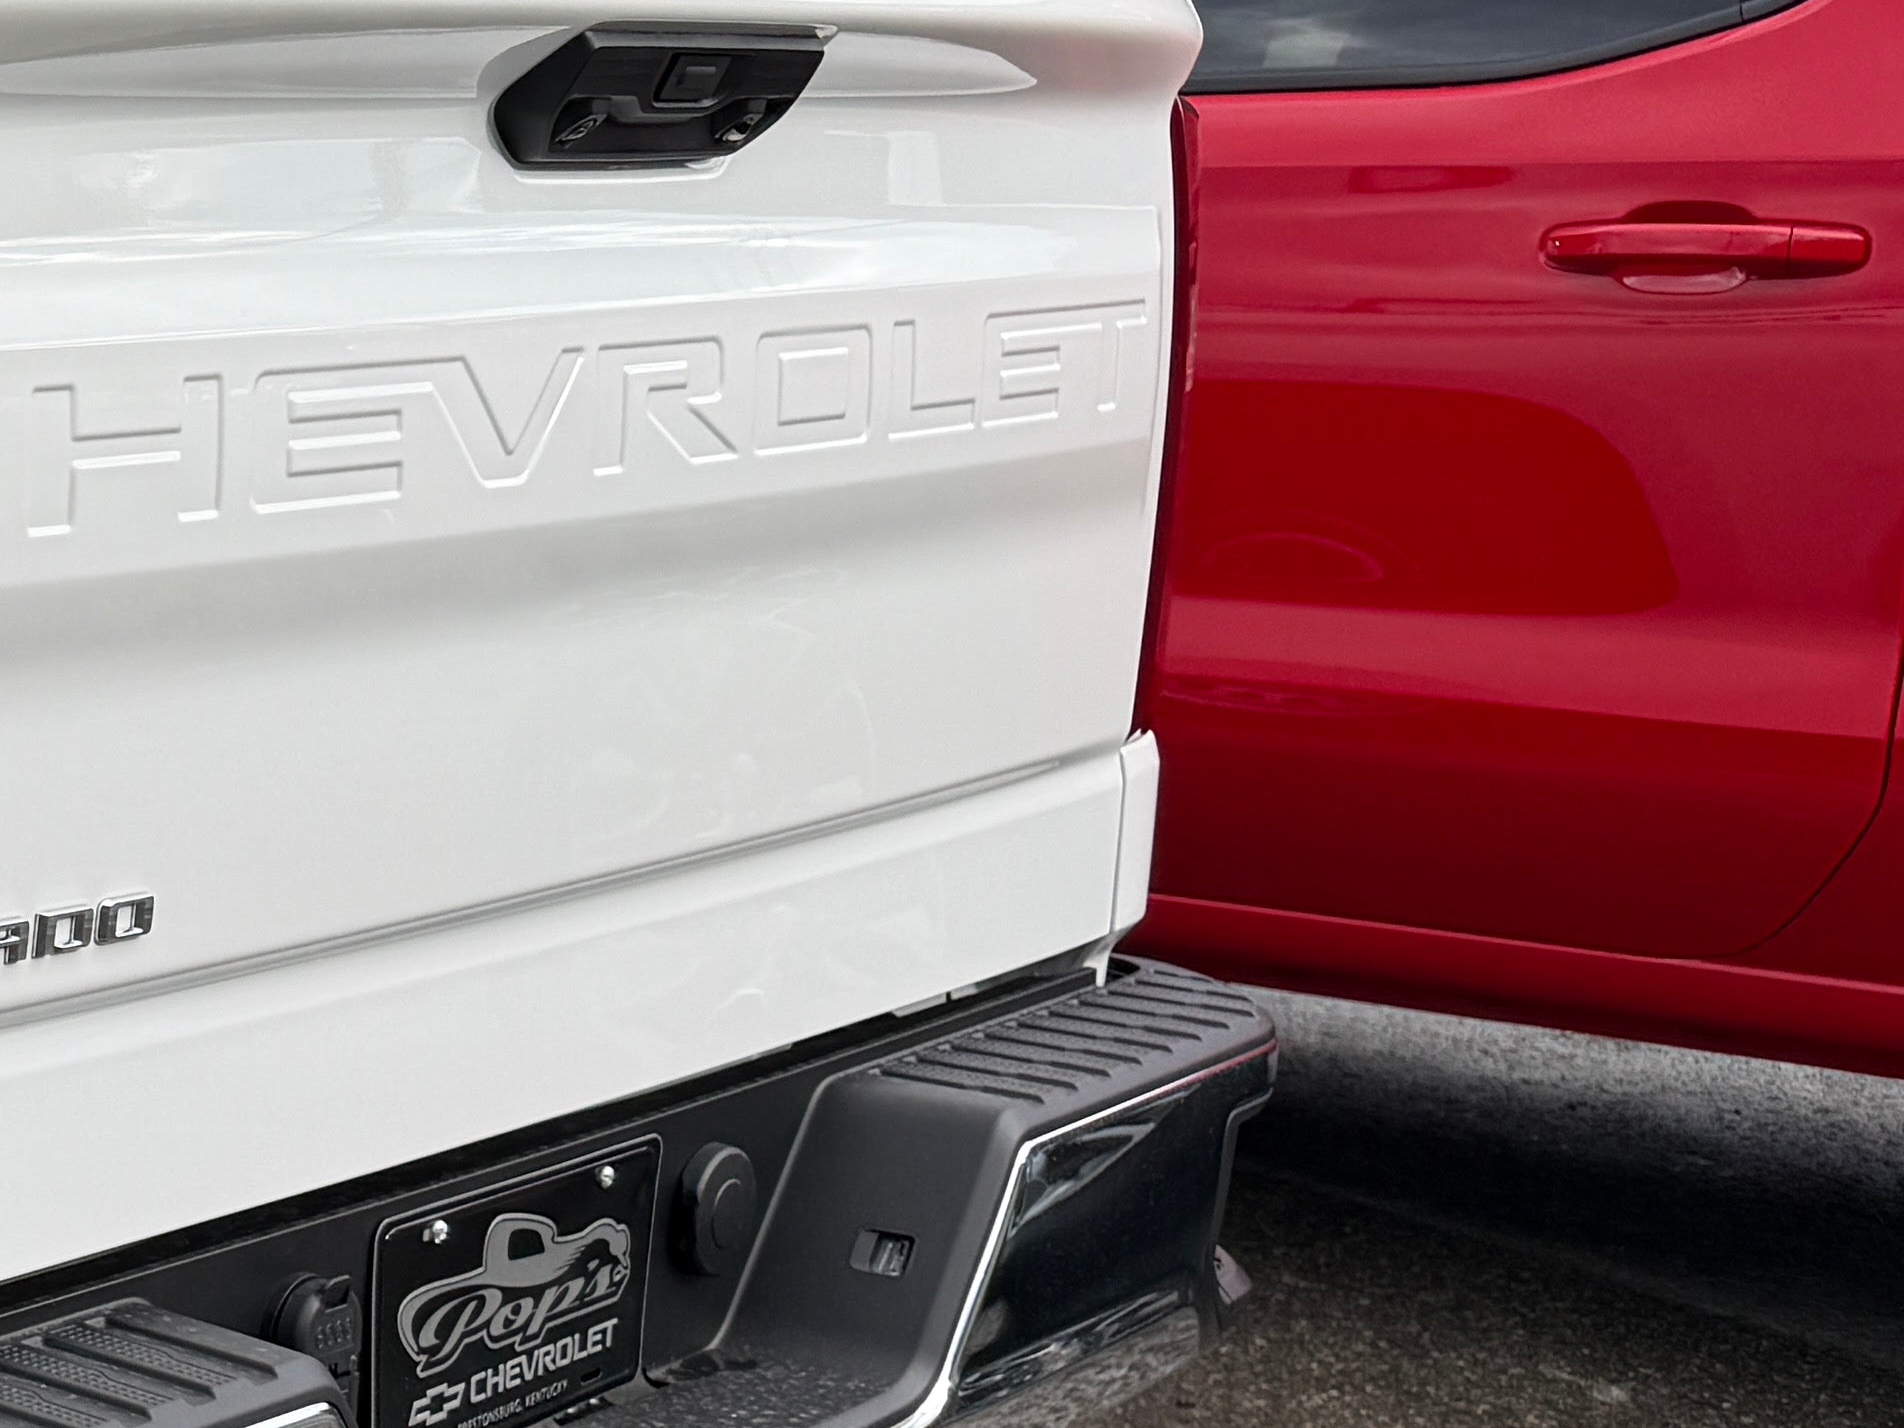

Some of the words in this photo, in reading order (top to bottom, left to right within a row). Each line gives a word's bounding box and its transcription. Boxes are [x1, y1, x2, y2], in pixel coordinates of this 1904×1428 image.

[418, 1258, 629, 1361] Pop's
[470, 1316, 619, 1404] CHEVROLET
[524, 1378, 569, 1408] KENTUCKY
